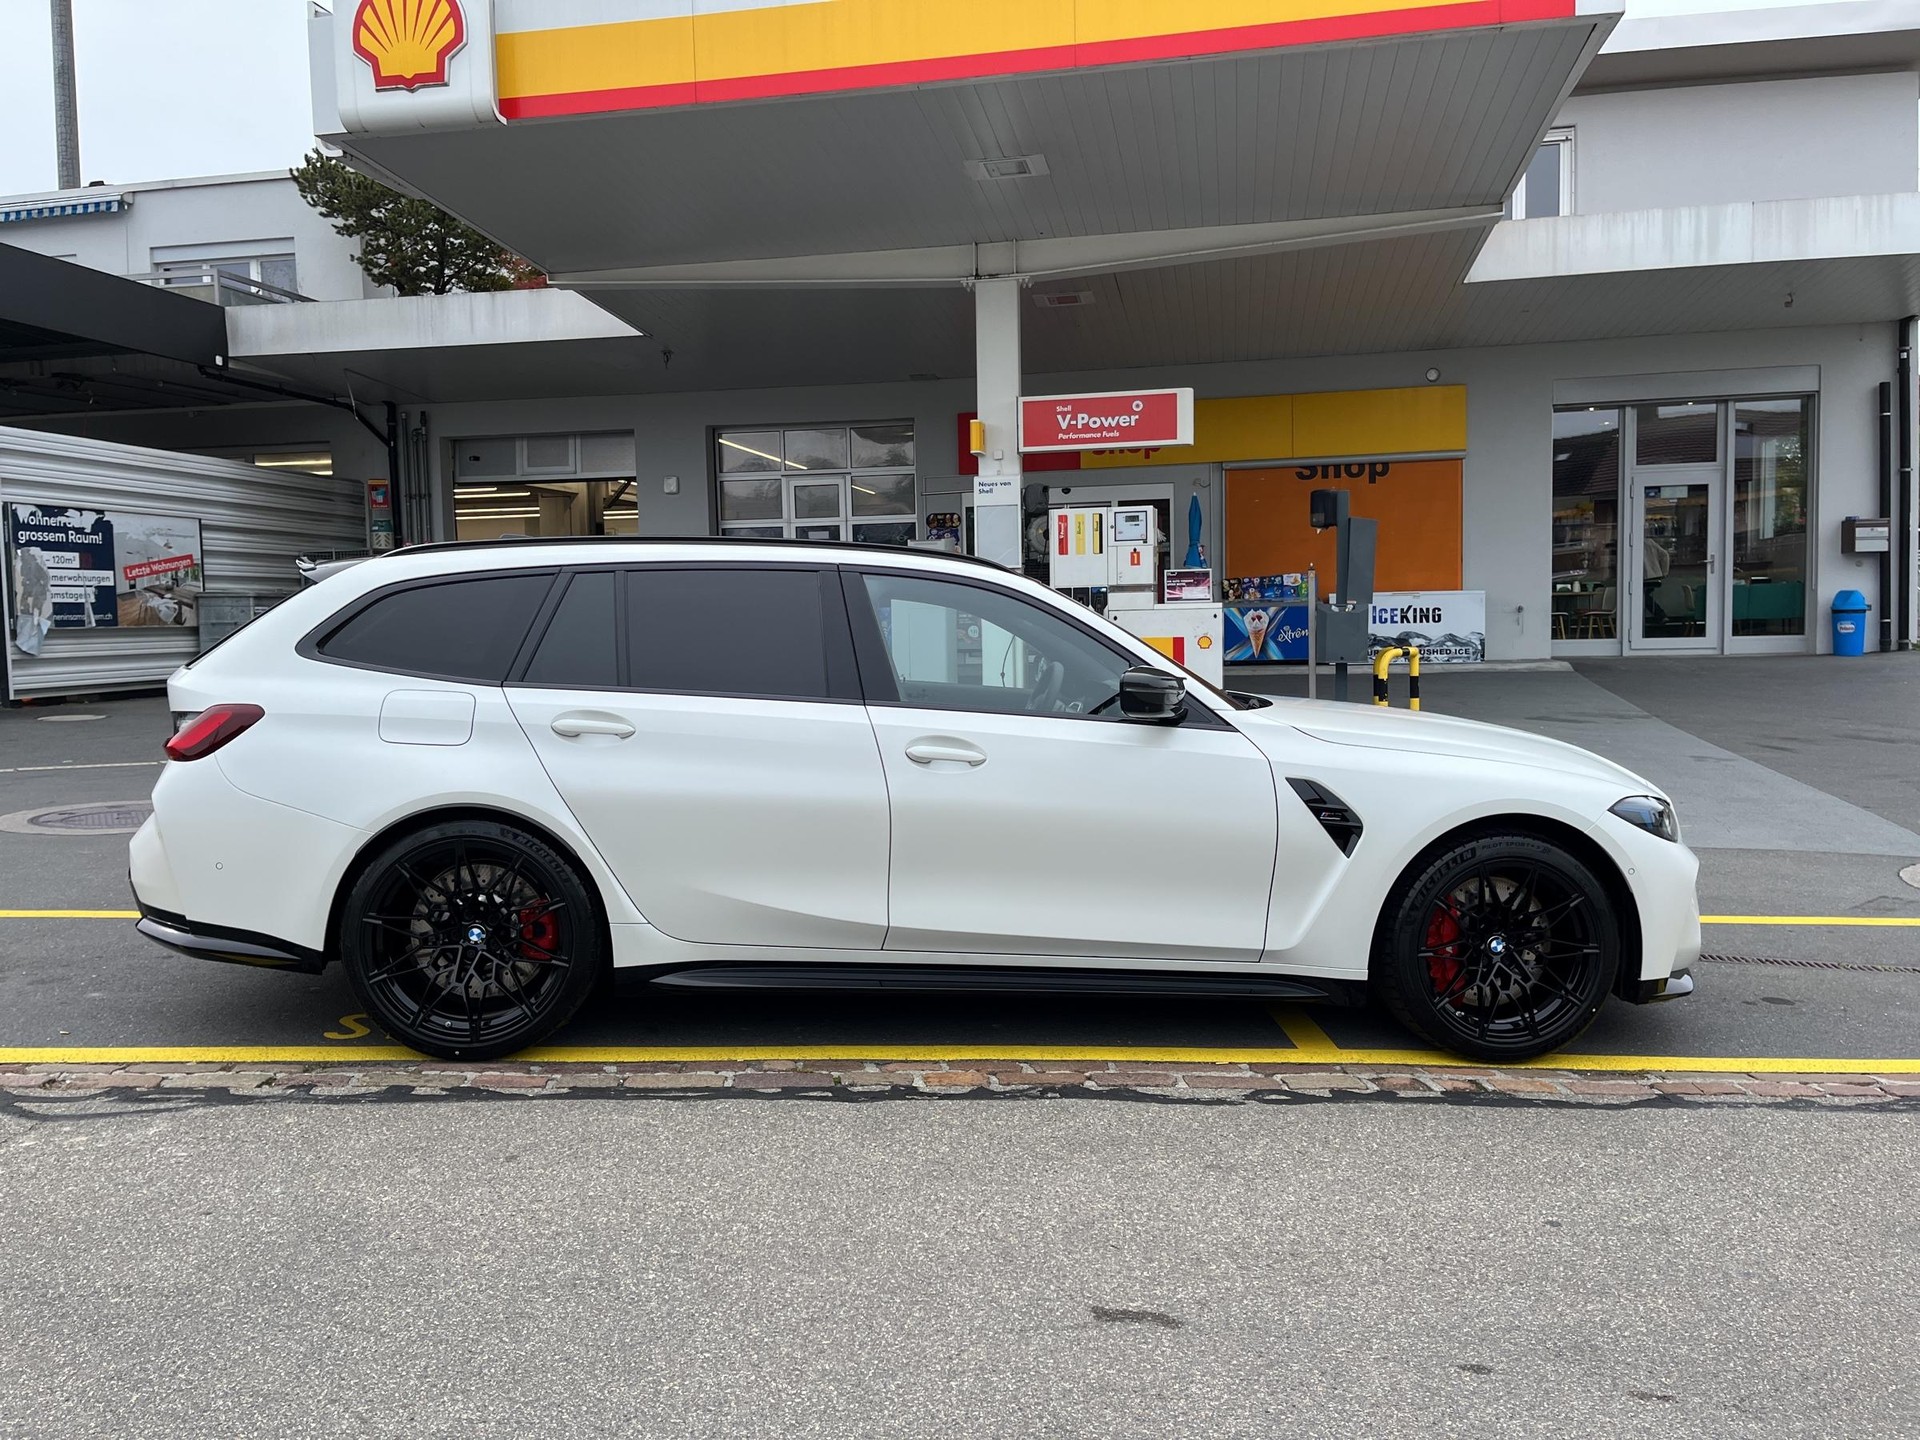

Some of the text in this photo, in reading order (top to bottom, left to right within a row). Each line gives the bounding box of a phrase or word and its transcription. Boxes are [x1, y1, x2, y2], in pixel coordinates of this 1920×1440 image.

[1056, 404, 1072, 413] Shell
[1056, 413, 1139, 430] V-Power
[1058, 430, 1120, 440] Performance Fuels
[18, 530, 103, 545] grossem Raum!
[1133, 552, 1138, 564] 1
[126, 559, 191, 577] Letzte Wohnungen
[50, 573, 111, 584] merwohnungen
[1419, 648, 1452, 656] USHED
